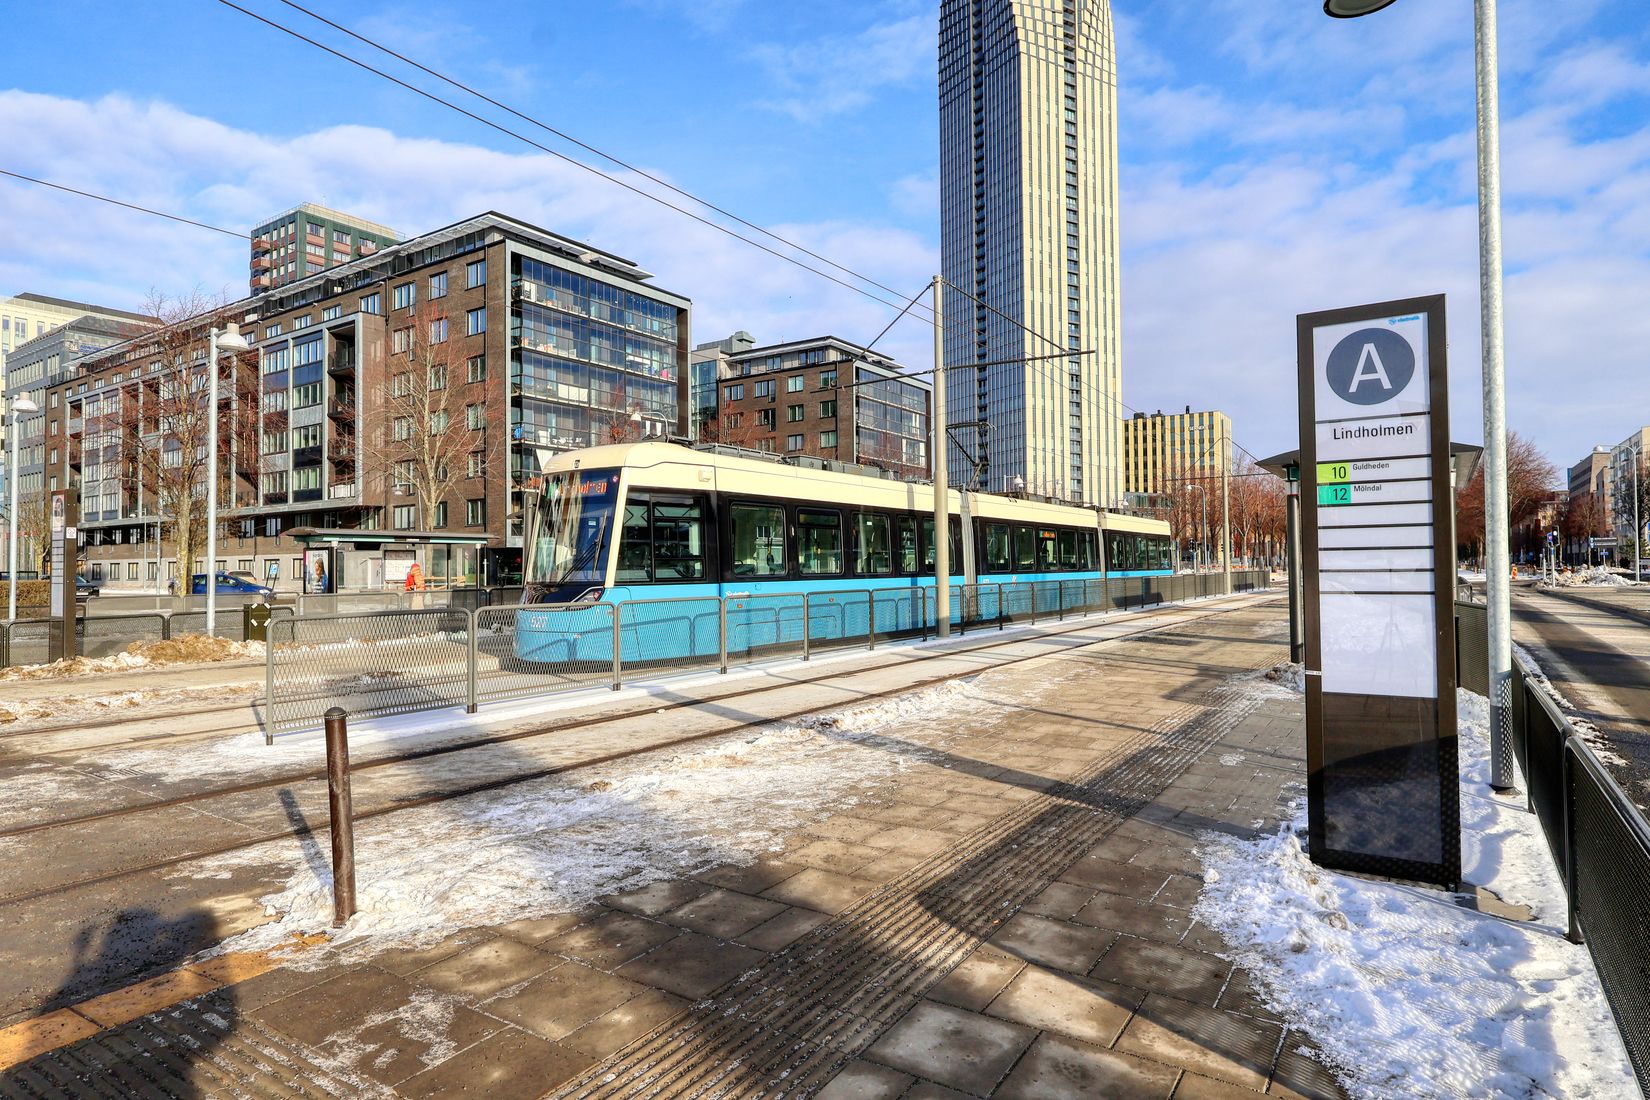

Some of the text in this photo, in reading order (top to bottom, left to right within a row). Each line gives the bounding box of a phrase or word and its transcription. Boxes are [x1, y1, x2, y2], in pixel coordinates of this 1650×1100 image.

[1348, 342, 1393, 394] A
[1333, 422, 1413, 440] Lindholmen
[1331, 460, 1390, 480] 10 Guldheden
[1333, 484, 1382, 501] 12 Mölndal
